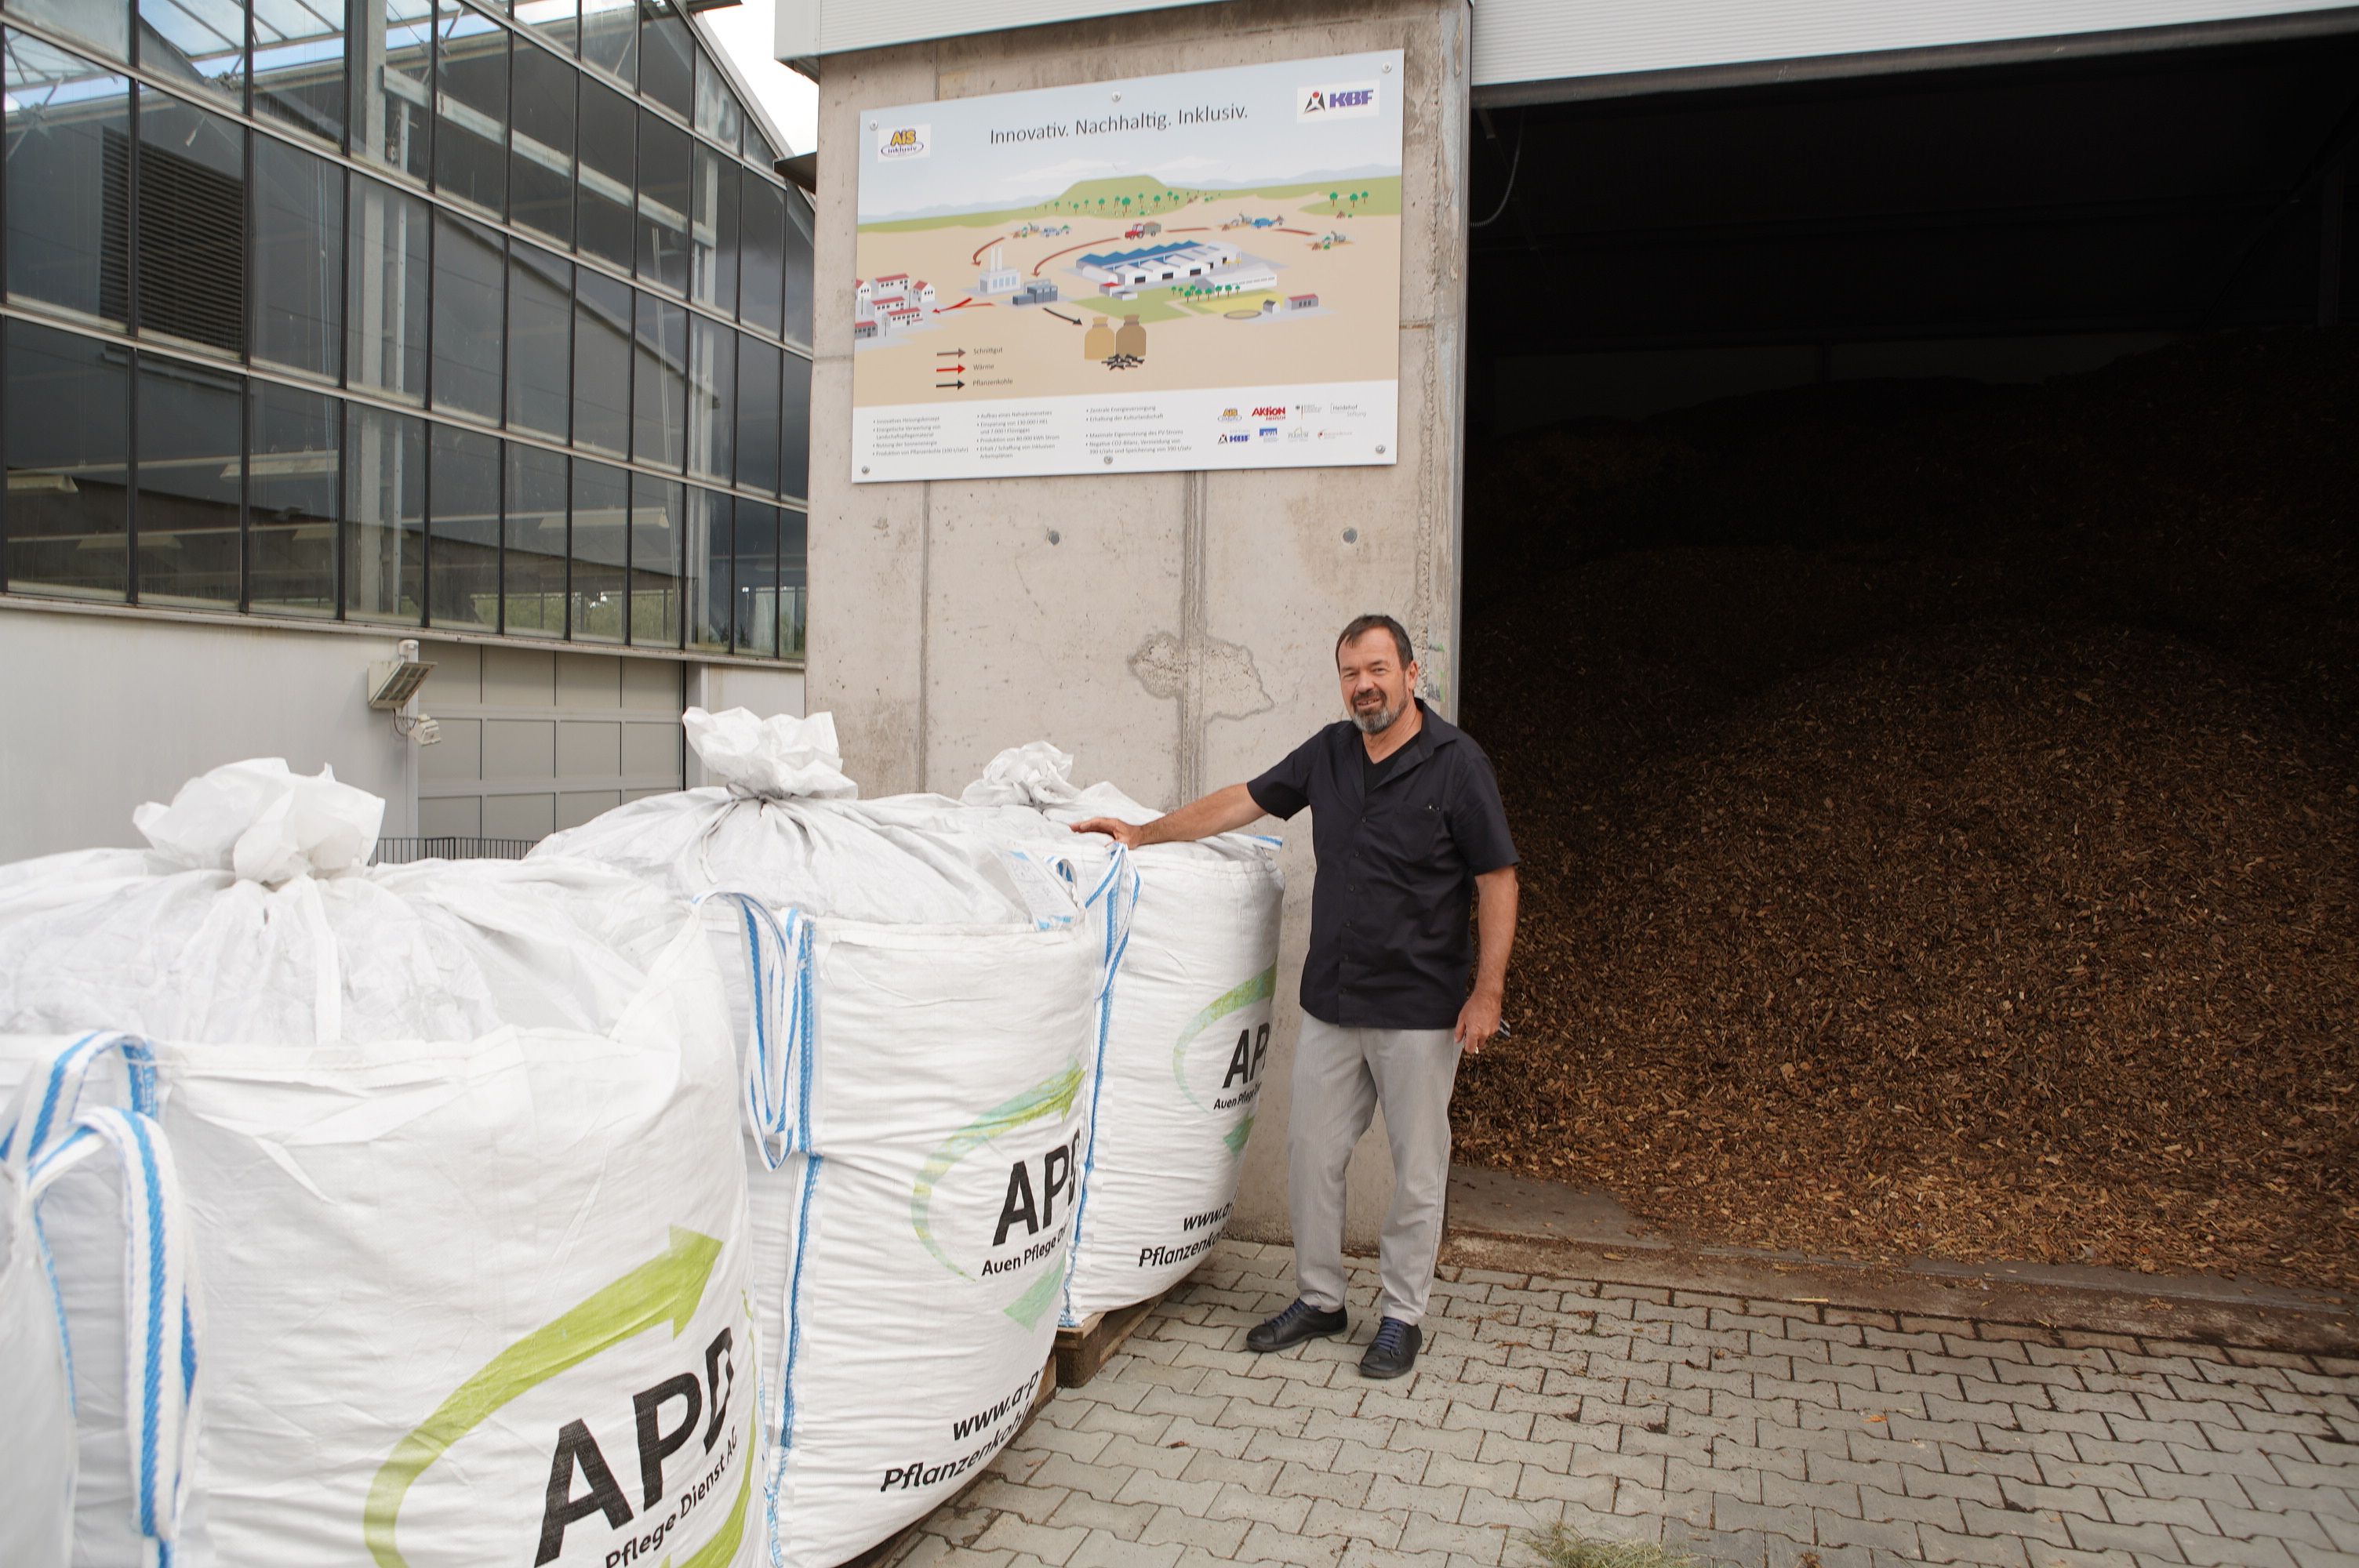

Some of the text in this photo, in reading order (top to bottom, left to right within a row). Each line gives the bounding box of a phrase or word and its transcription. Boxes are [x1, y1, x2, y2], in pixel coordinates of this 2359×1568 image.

[1329, 89, 1374, 110] KBF
[990, 103, 1248, 145] Innovativ. Nachhaltig. Inklusiv.
[973, 347, 1003, 355] Schnittgut
[972, 378, 1013, 387] Pflanzenkohle
[1222, 1022, 1271, 1089] AP
[1213, 1098, 1237, 1110] Auen
[1183, 1201, 1234, 1232] www.a-
[981, 1236, 1056, 1276] Auen Pflege
[1139, 1227, 1223, 1268] Pflanzenko
[953, 1366, 1045, 1441] www.a-p-
[533, 1327, 735, 1568] APD
[880, 1400, 1033, 1493] Pflanzenkohl
[605, 1512, 677, 1568] Pflege
[680, 1453, 725, 1520] Dienst
